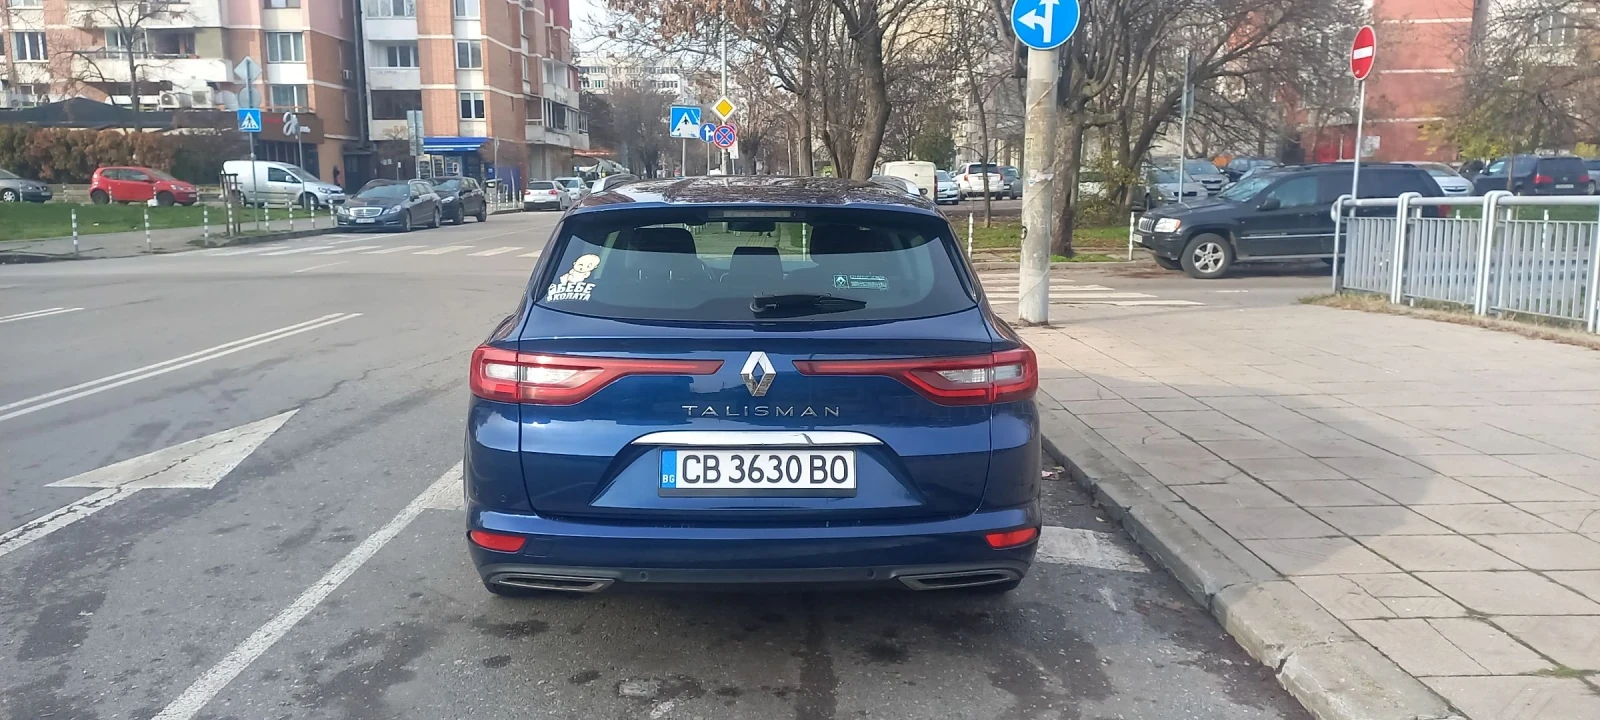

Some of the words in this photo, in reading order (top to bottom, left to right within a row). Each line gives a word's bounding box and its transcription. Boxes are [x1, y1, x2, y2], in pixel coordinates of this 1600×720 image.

[557, 282, 596, 294] БЕБЕ
[681, 405, 840, 418] TALISMAN
[682, 454, 722, 484] CB
[728, 454, 803, 484] 3630
[809, 454, 849, 484] BO
[662, 475, 675, 484] BG
